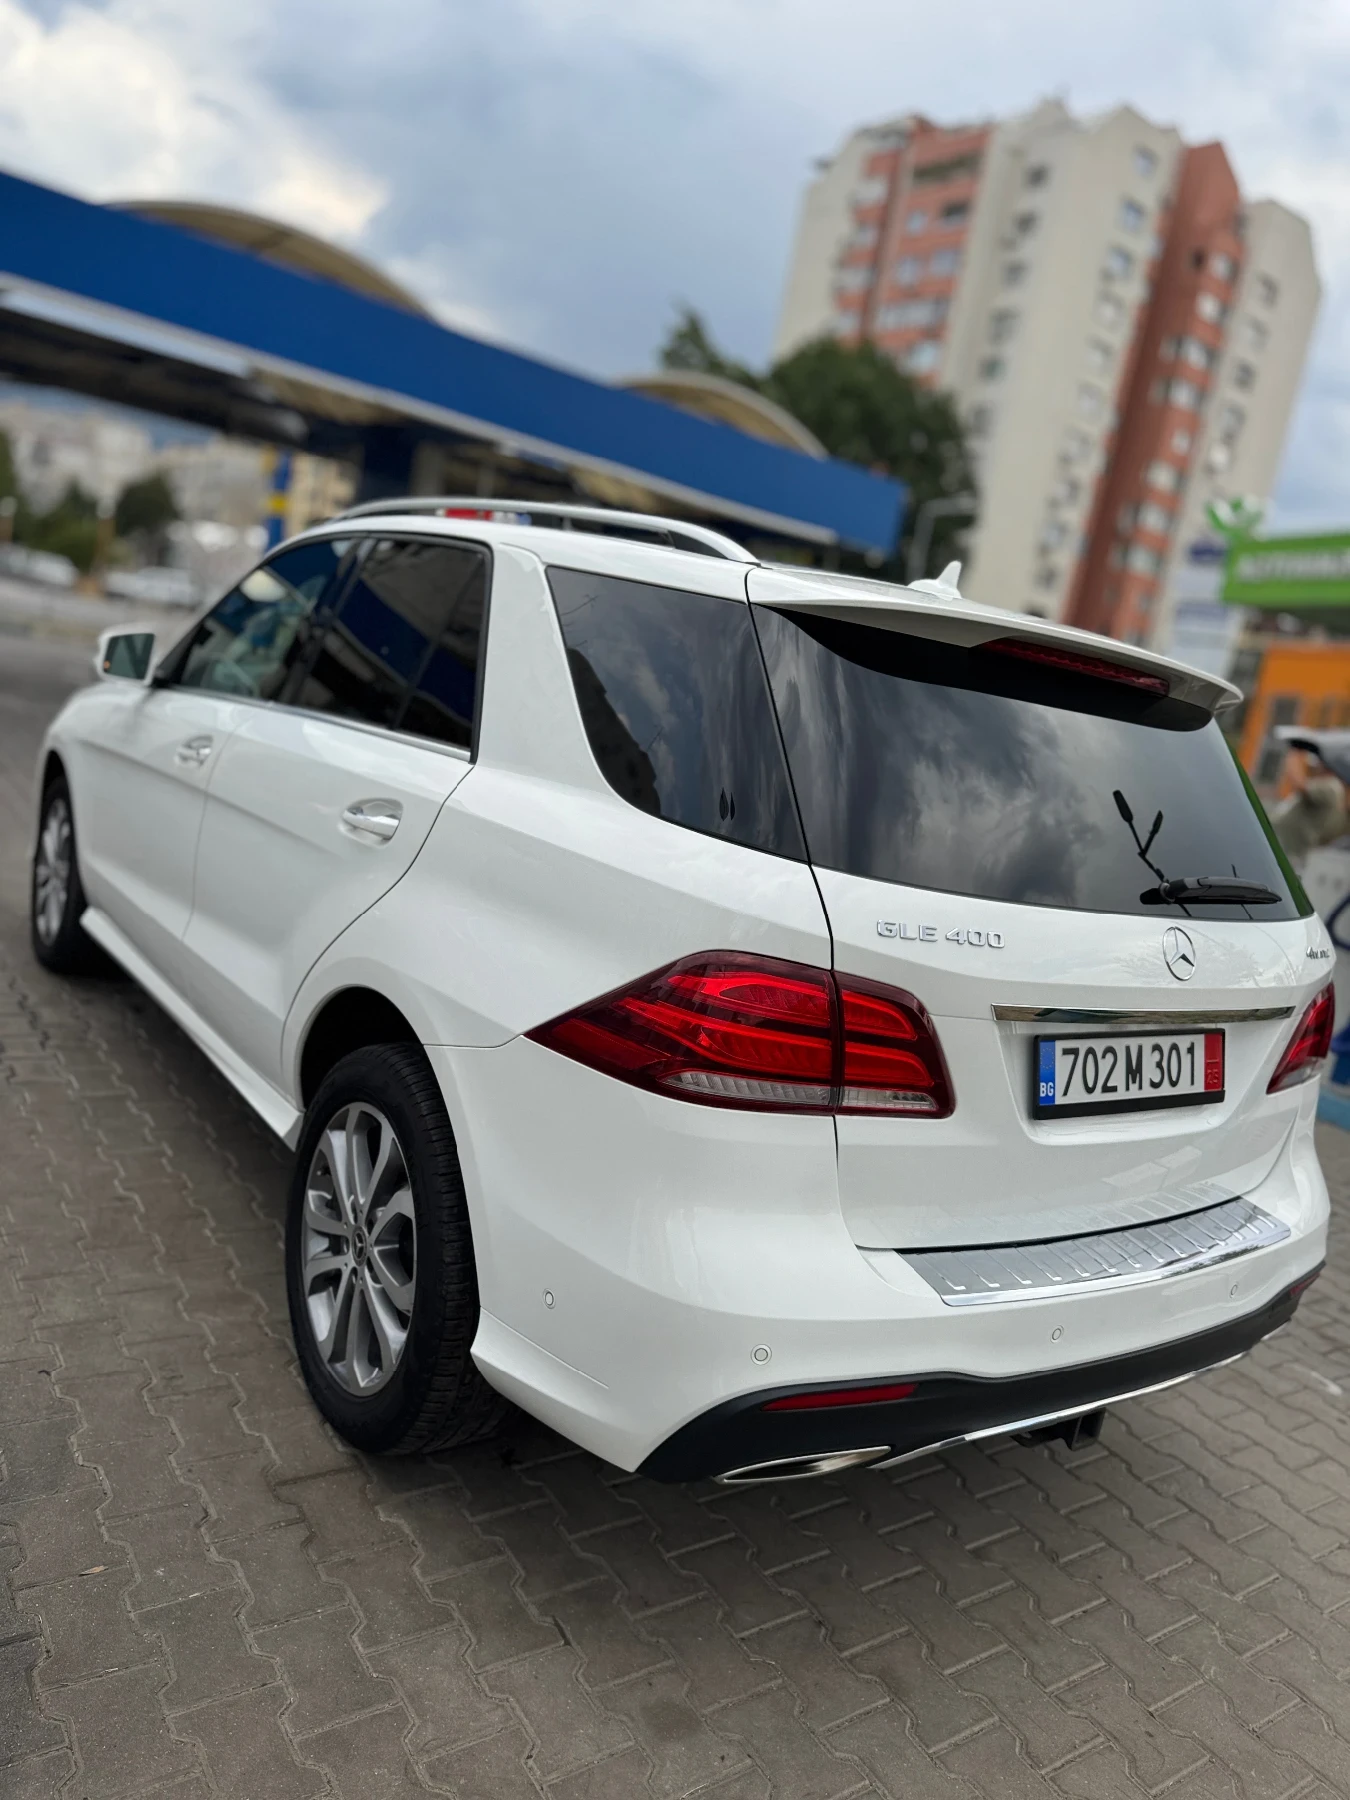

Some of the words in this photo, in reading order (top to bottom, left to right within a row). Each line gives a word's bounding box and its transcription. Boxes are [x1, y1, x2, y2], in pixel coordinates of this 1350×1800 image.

[877, 919, 938, 942] GLE
[945, 927, 1005, 949] 400
[1039, 1082, 1054, 1097] BG
